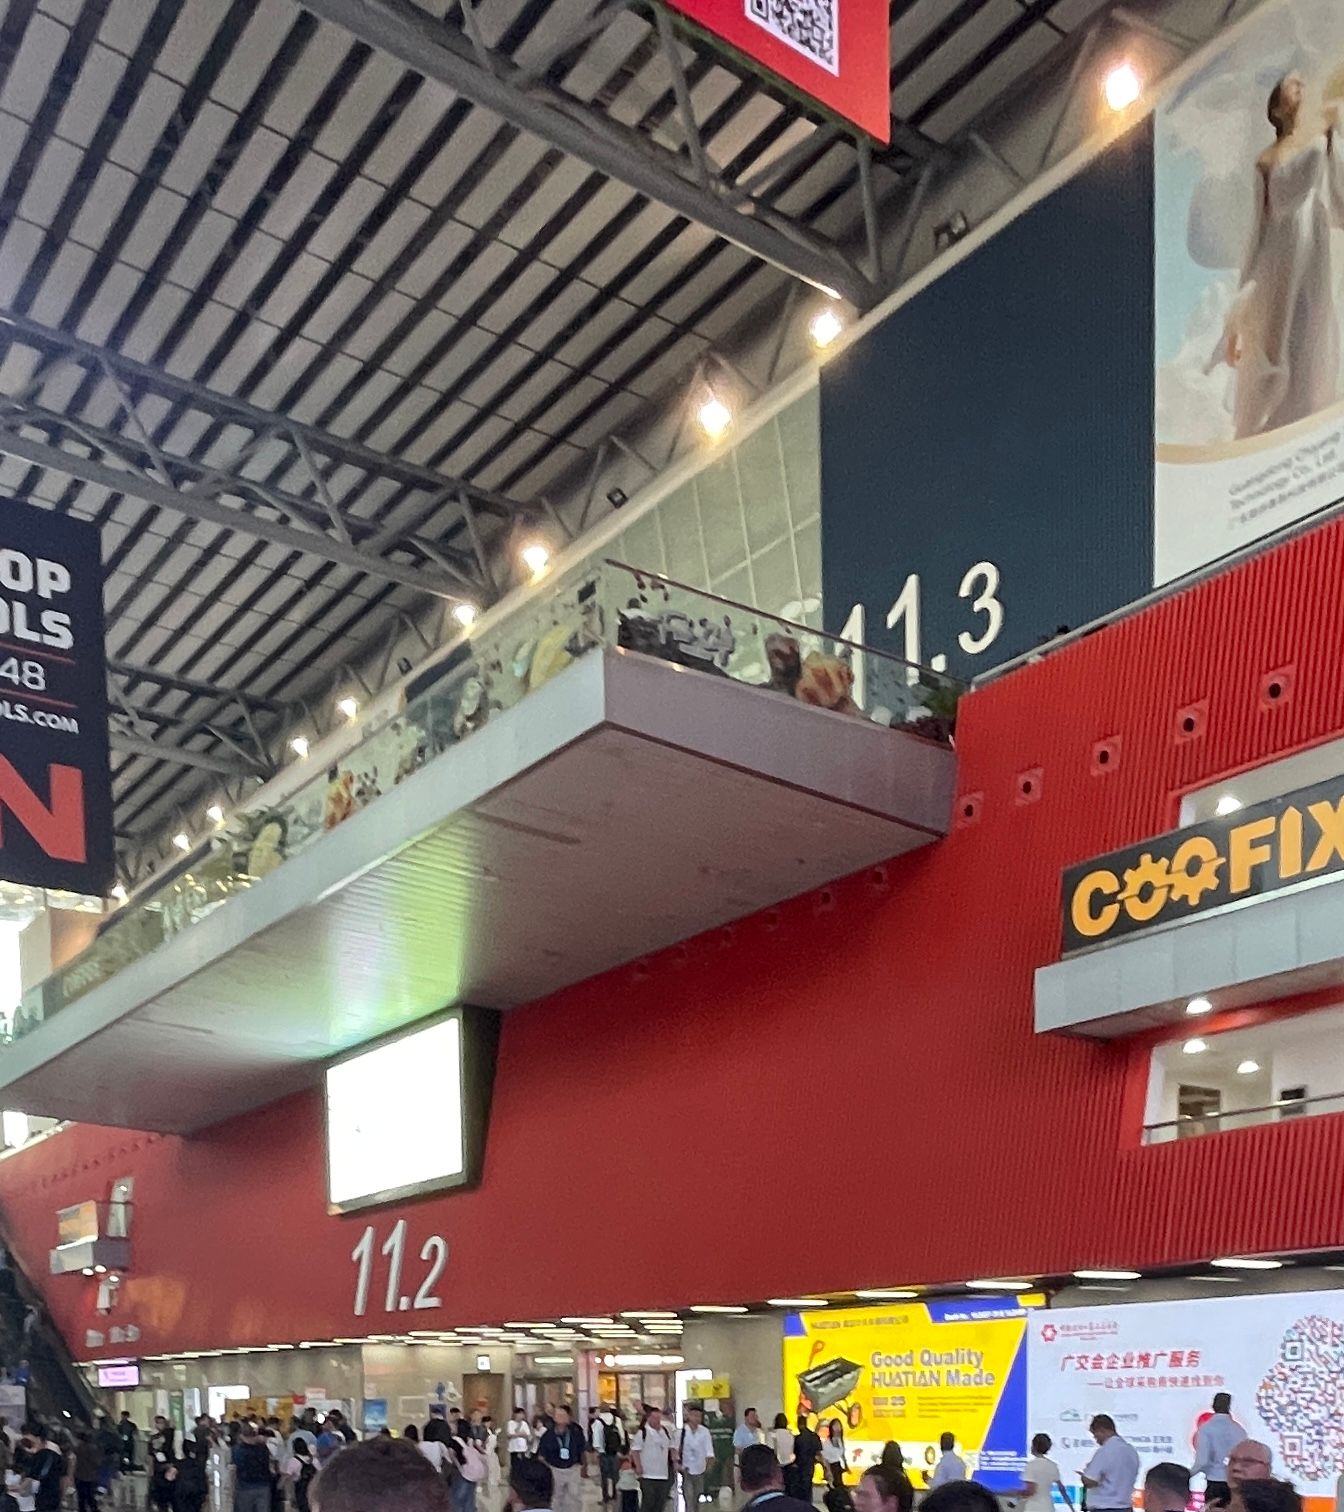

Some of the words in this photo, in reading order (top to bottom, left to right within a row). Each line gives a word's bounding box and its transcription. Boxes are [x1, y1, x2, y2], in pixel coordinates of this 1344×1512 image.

[834, 561, 1003, 711] 11.3
[352, 1220, 449, 1316] 11.2
[871, 1351, 914, 1368] Good
[920, 1348, 984, 1369] Quality
[871, 1370, 941, 1387] HUATIAN
[945, 1369, 995, 1386] Made
